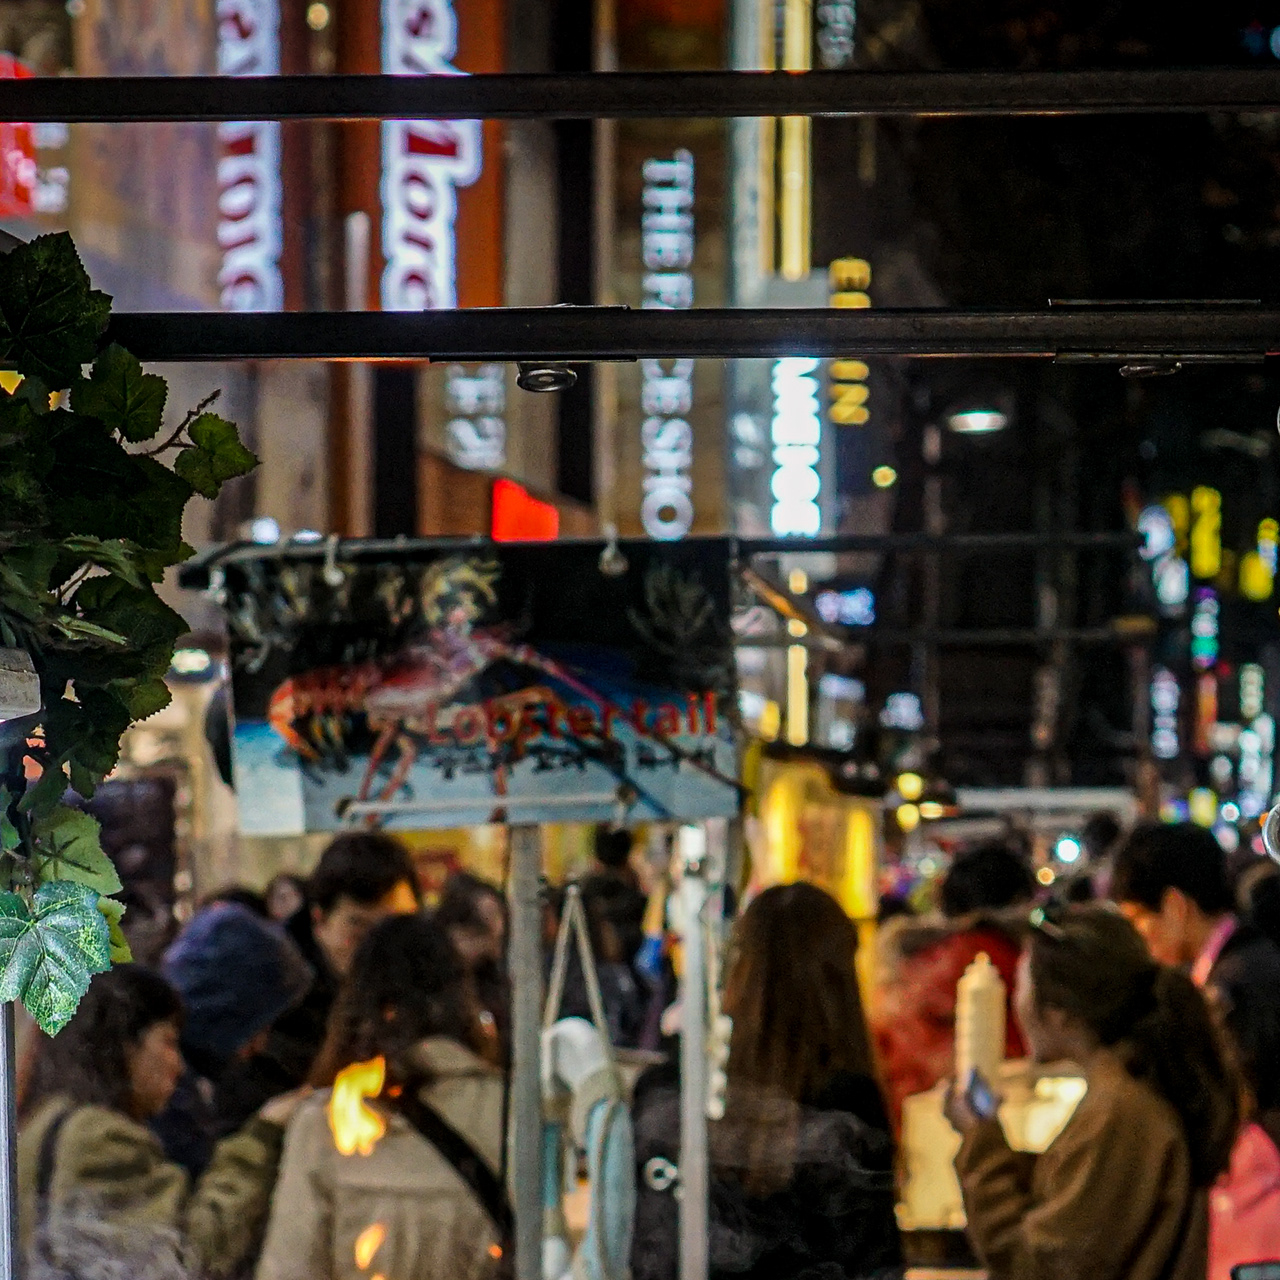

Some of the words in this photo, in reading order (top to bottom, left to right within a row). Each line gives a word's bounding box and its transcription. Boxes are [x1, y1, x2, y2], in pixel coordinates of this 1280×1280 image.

[641, 148, 695, 268] THE
[426, 694, 624, 746] Lobster
[630, 691, 717, 738] tail
